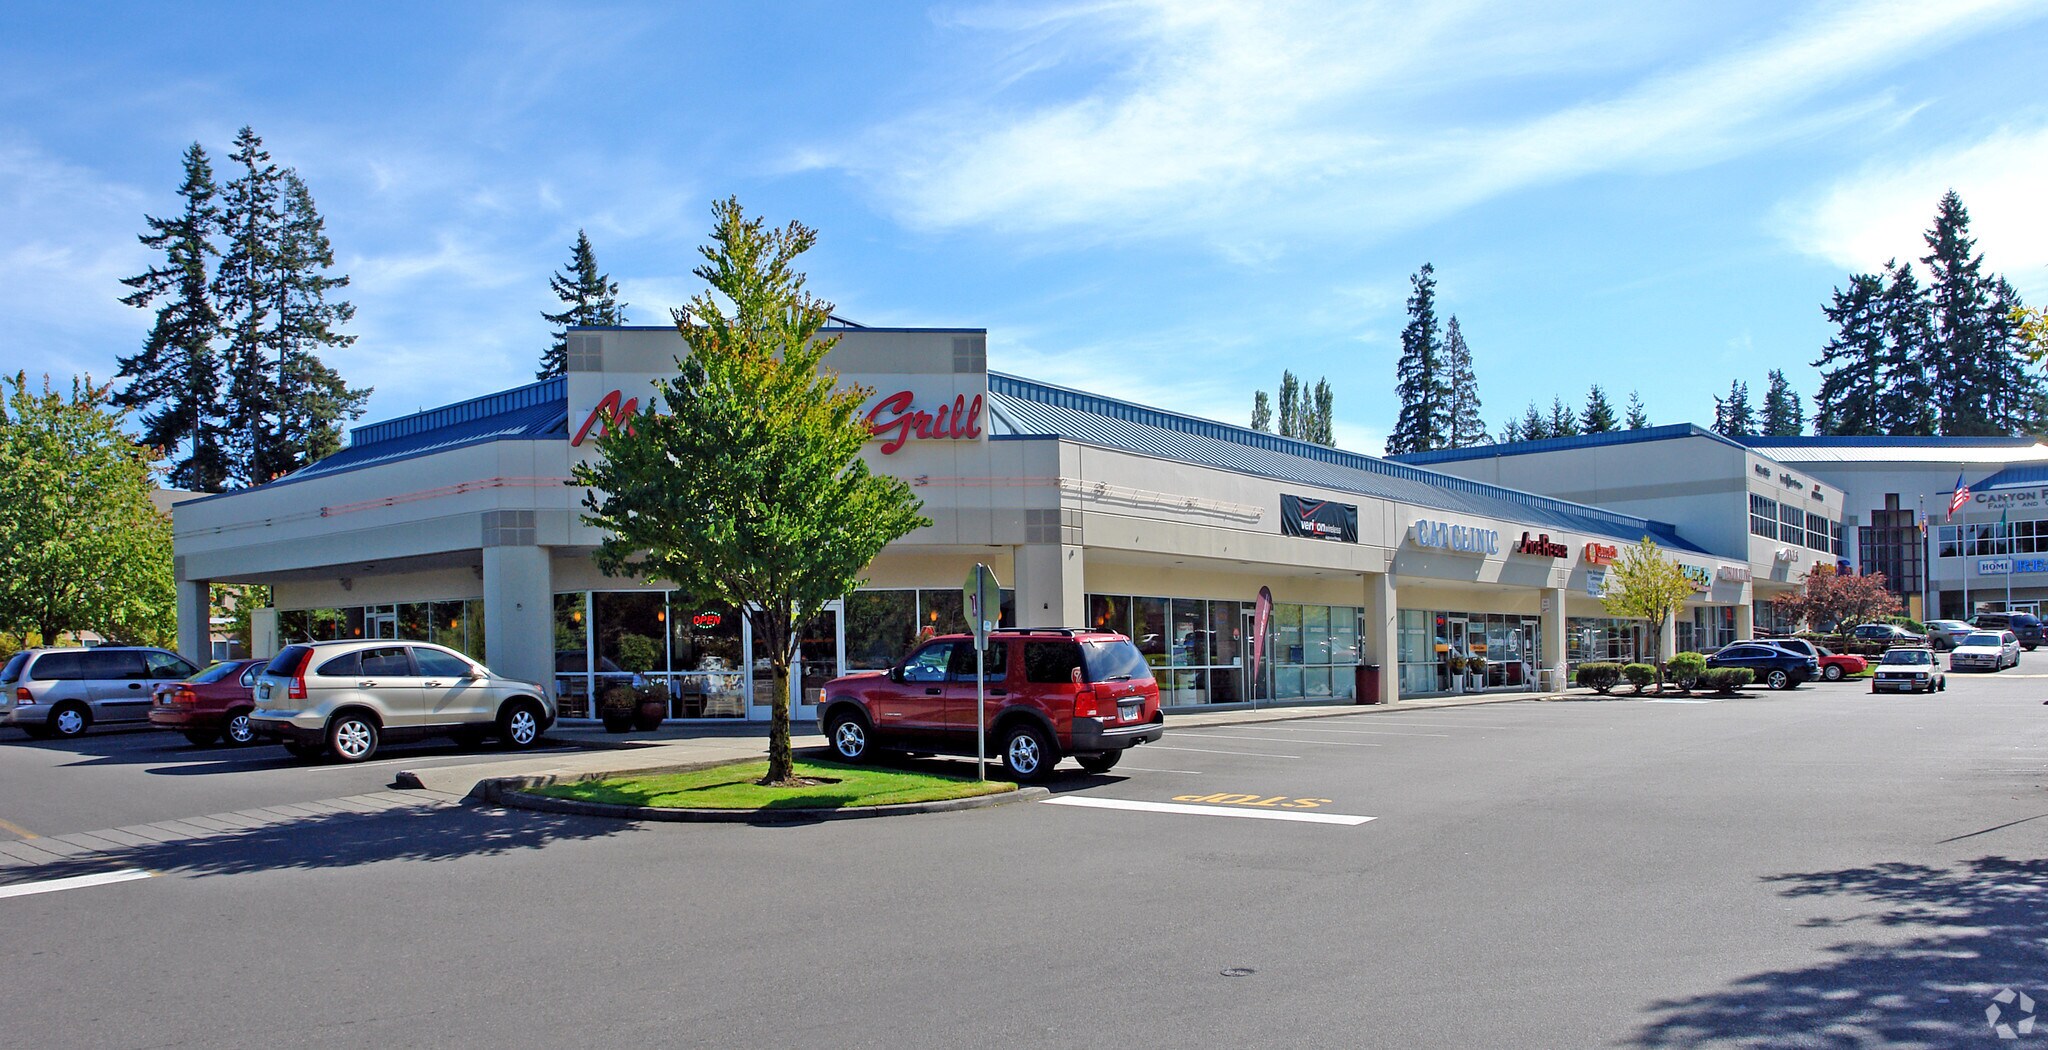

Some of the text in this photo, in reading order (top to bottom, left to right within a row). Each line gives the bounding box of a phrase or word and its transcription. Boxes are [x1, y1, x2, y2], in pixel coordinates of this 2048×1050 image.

[865, 390, 983, 455] Grill
[1975, 491, 2036, 504] CANYON
[1987, 502, 2015, 510] FAMLY
[1300, 518, 1327, 535] verizon
[1417, 519, 1499, 555] CAT CLINIC
[693, 615, 722, 625] OPEN
[1171, 792, 1334, 809] STOP
